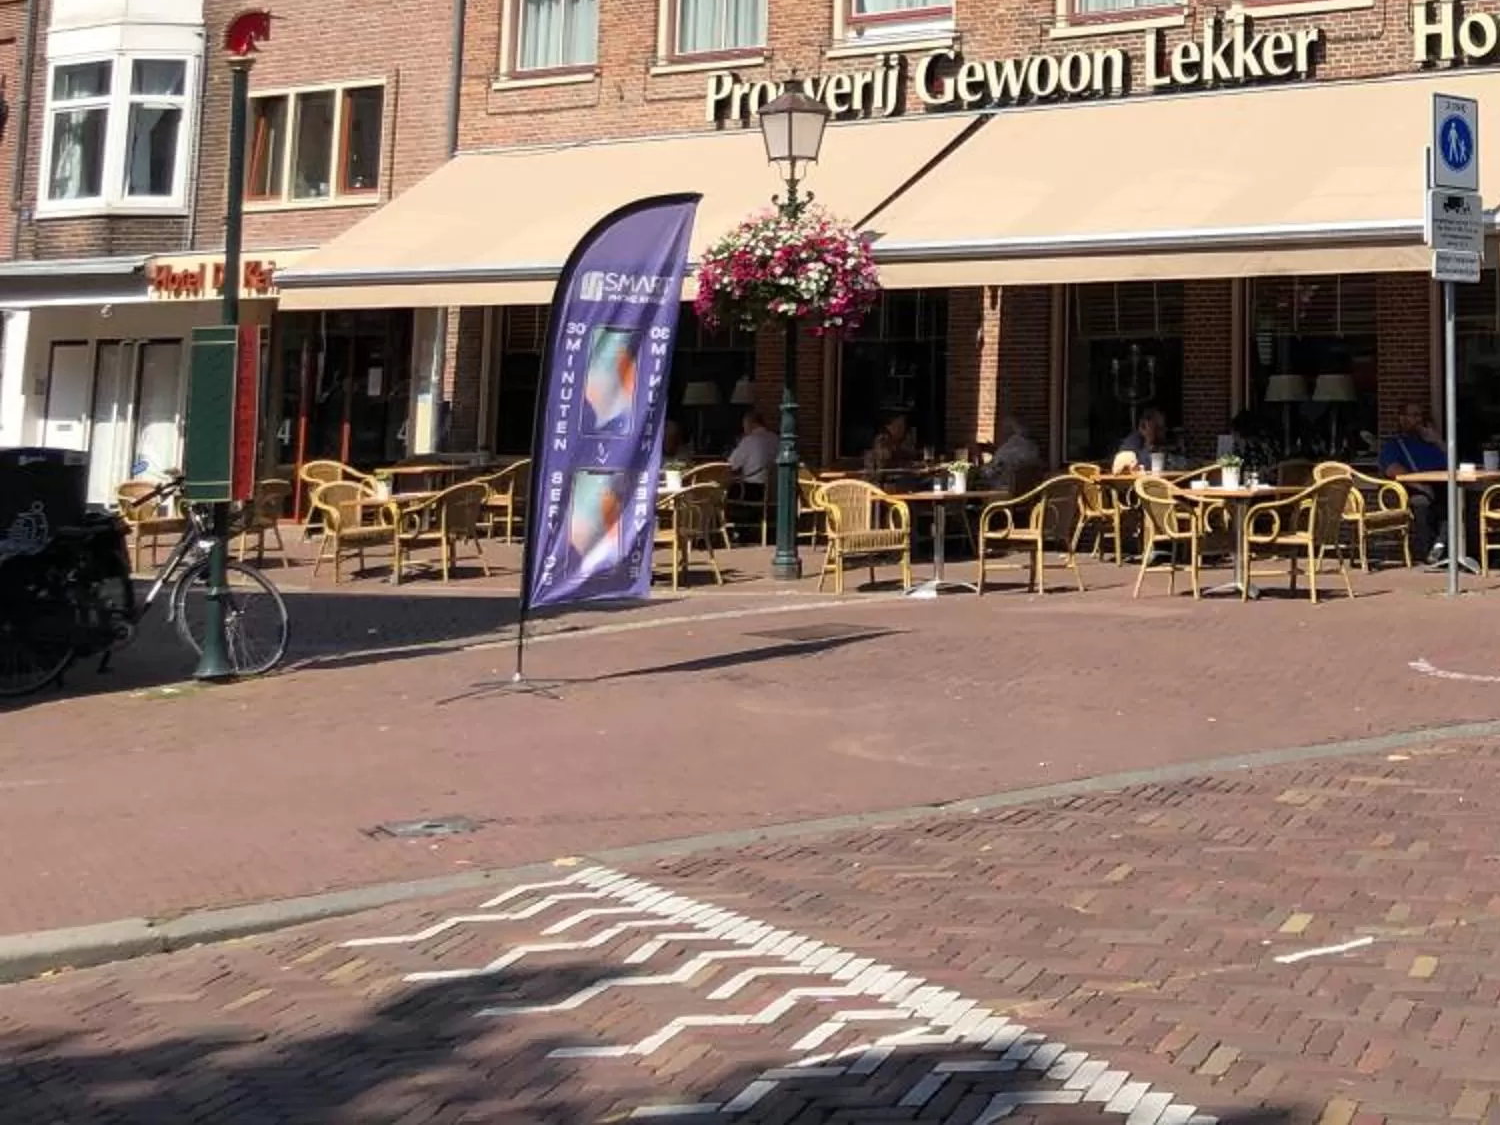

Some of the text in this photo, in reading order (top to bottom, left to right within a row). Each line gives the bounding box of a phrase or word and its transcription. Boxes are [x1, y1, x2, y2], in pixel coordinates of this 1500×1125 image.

[706, 13, 1319, 123] Proverij Gewoon Lekker
[156, 263, 206, 291] Hotel
[604, 272, 674, 293] SMART
[567, 322, 587, 335] 30
[553, 338, 582, 451] MINUTEN
